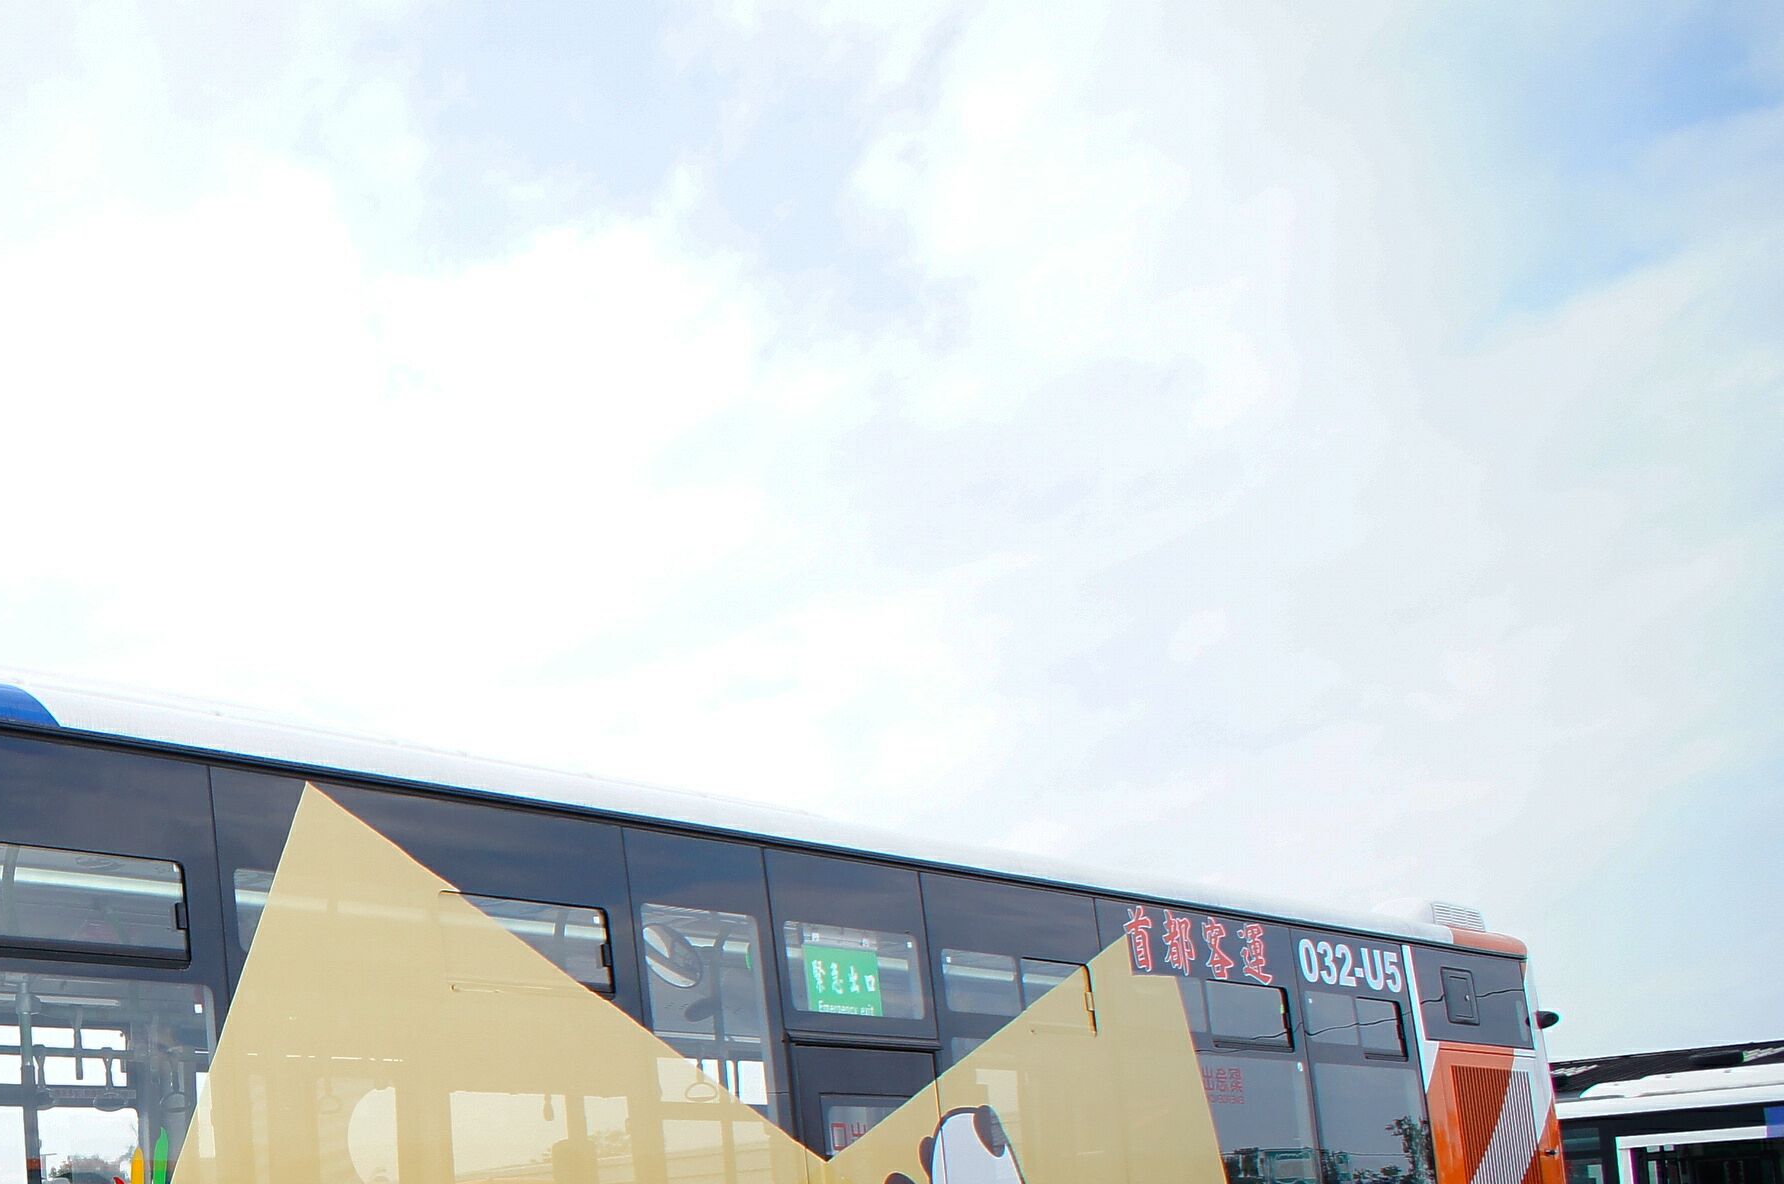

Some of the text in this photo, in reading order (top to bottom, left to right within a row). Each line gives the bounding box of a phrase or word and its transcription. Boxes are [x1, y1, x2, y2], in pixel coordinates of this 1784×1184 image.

[1123, 905, 1273, 986] 首都客運
[1298, 938, 1403, 993] 032-U5
